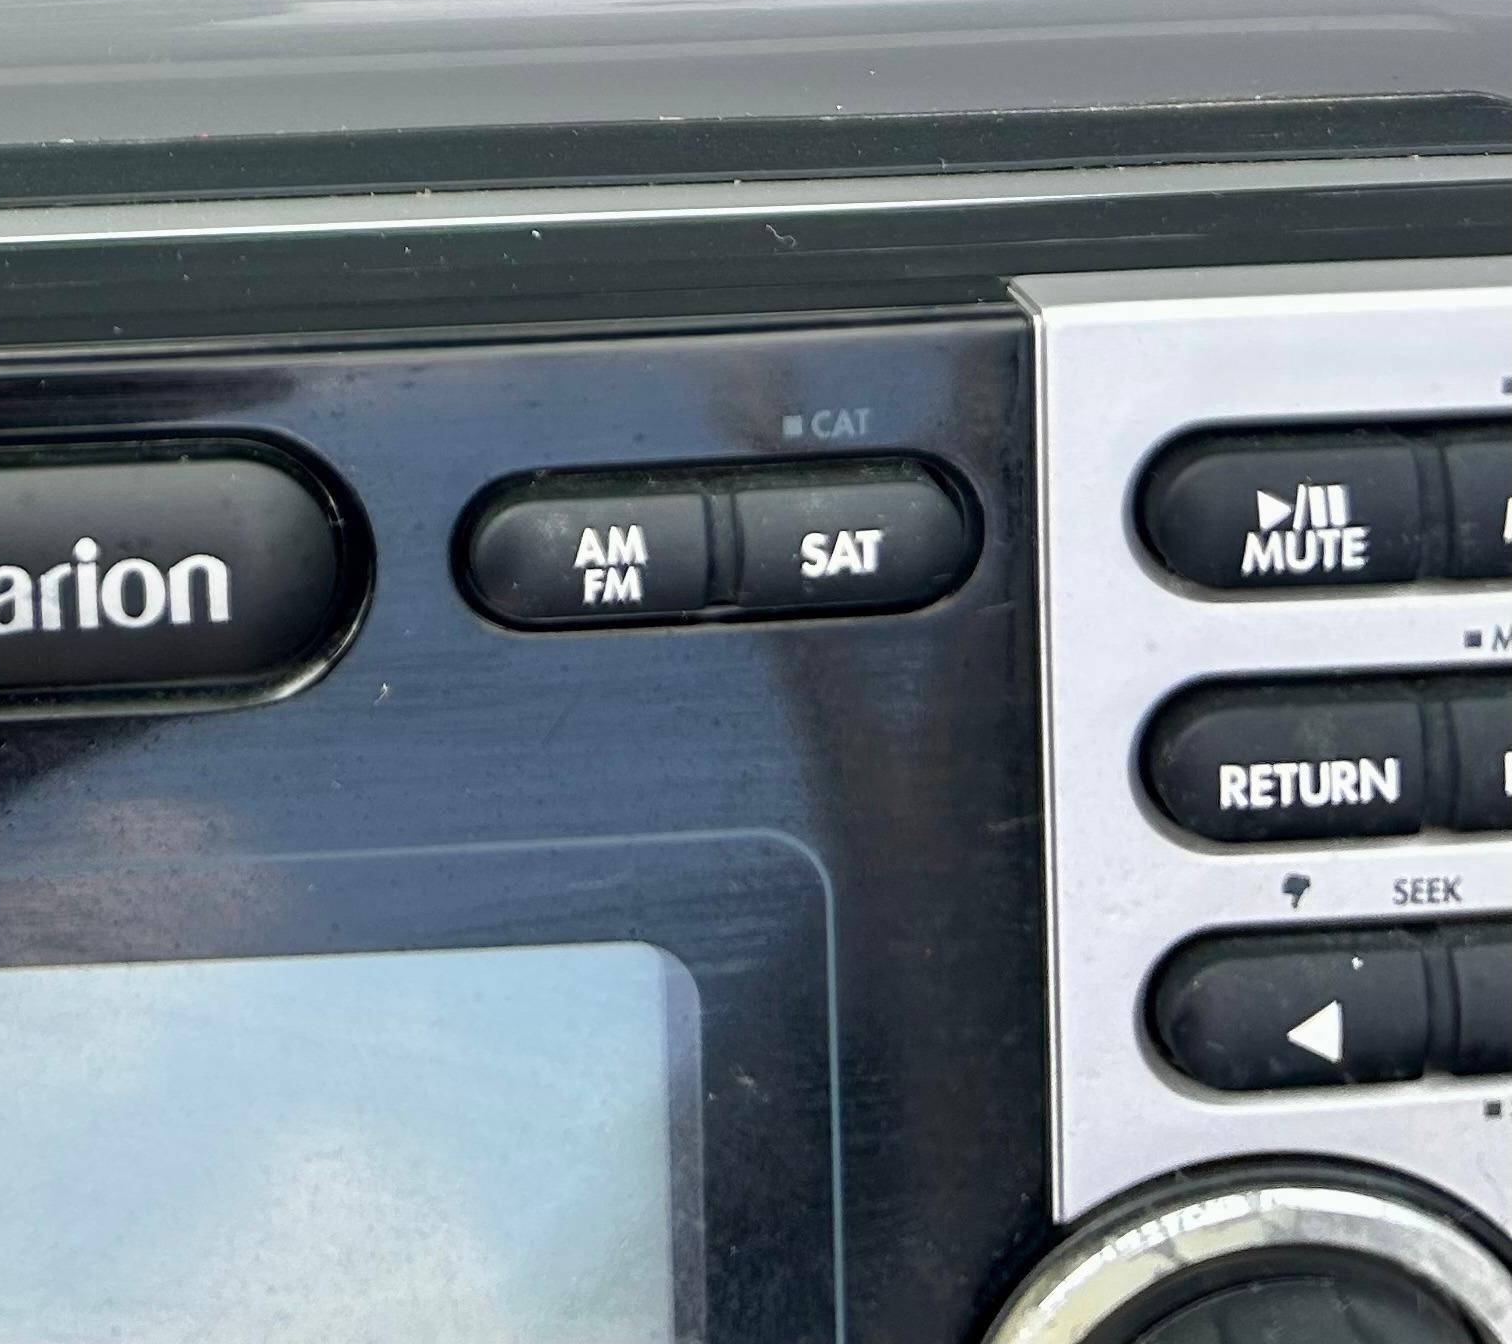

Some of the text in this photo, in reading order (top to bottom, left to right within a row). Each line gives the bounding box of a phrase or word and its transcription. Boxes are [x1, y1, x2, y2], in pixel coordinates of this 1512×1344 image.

[811, 408, 870, 439] CAT
[574, 524, 647, 568] AM
[800, 529, 883, 578] SAT
[1242, 526, 1370, 577] MUTE
[583, 565, 642, 605] FM
[1219, 757, 1401, 810] RETURN
[1392, 876, 1462, 905] SEEK
